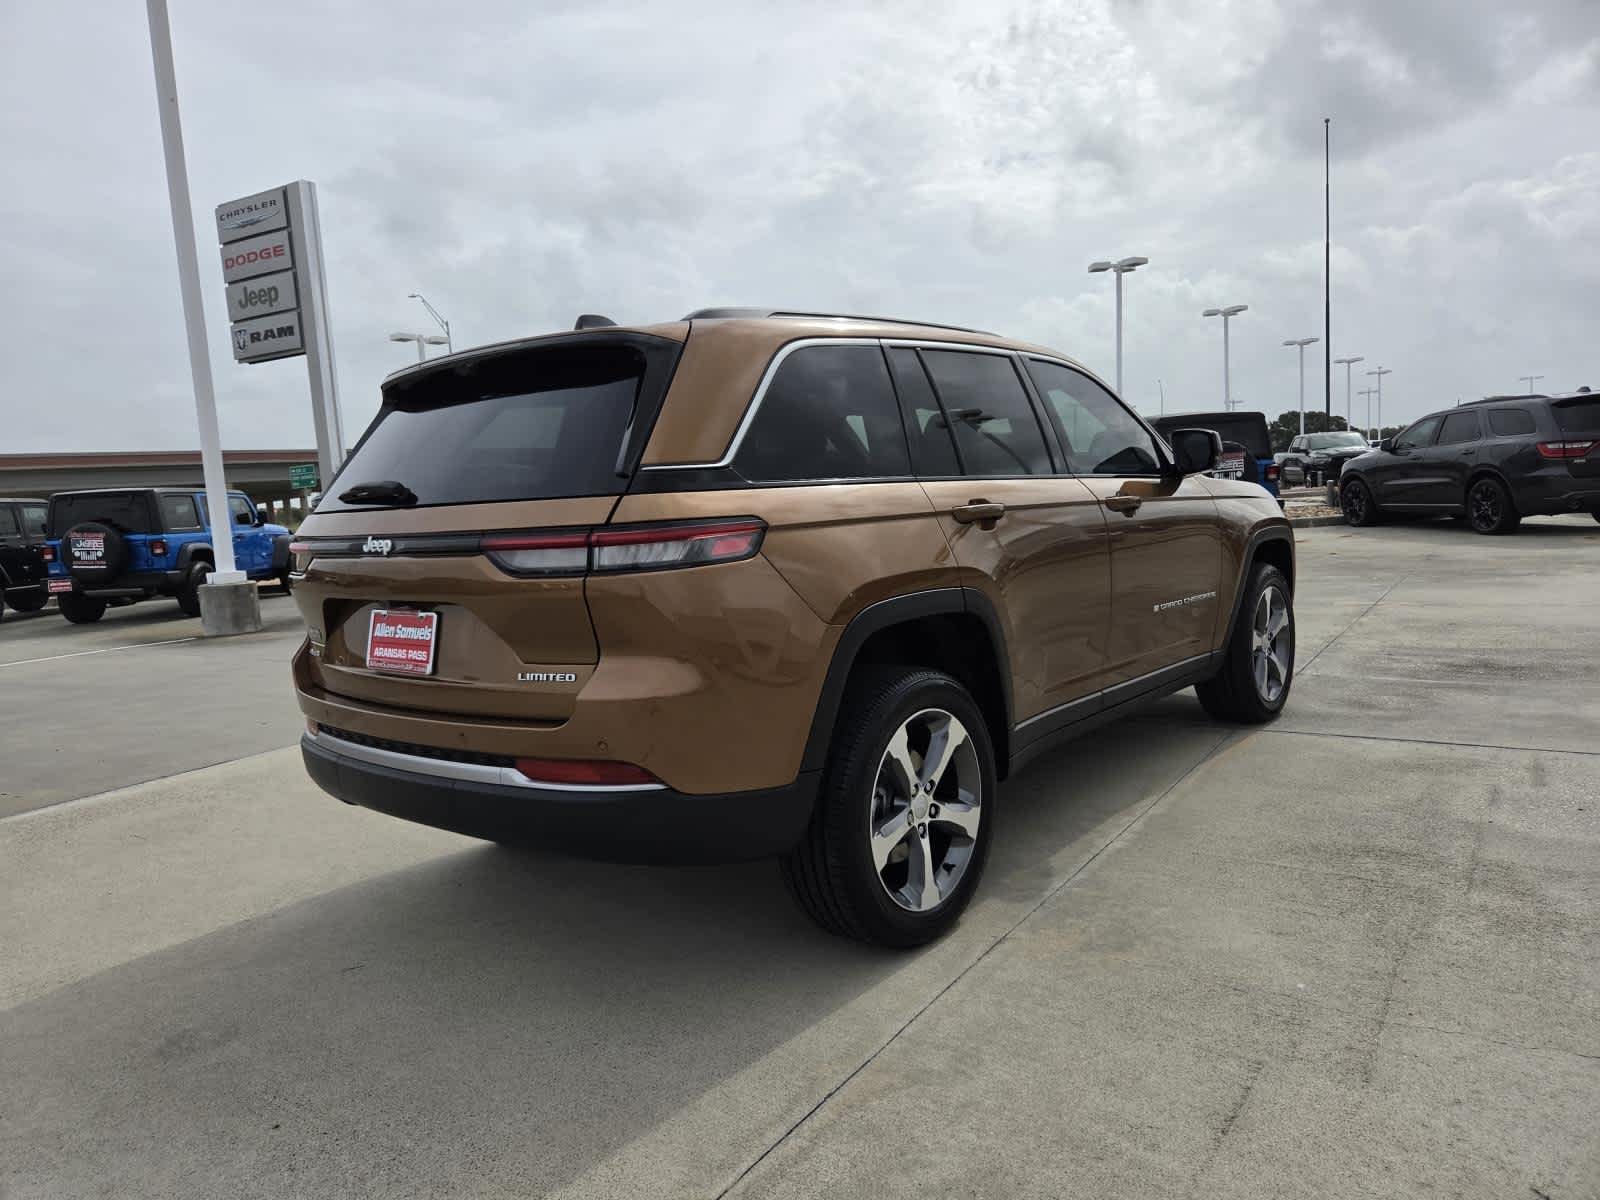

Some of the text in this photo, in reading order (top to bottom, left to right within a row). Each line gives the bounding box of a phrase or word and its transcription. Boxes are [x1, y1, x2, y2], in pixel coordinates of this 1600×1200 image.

[219, 199, 278, 222] CHRYSLER
[224, 245, 286, 271] DODGE
[238, 285, 279, 309] Jeep
[250, 325, 295, 344] RAM
[362, 536, 392, 555] Jeep
[374, 623, 432, 640] Allen Samuels
[374, 647, 428, 661] ARANSAS PASS
[517, 673, 576, 682] LIMITED
